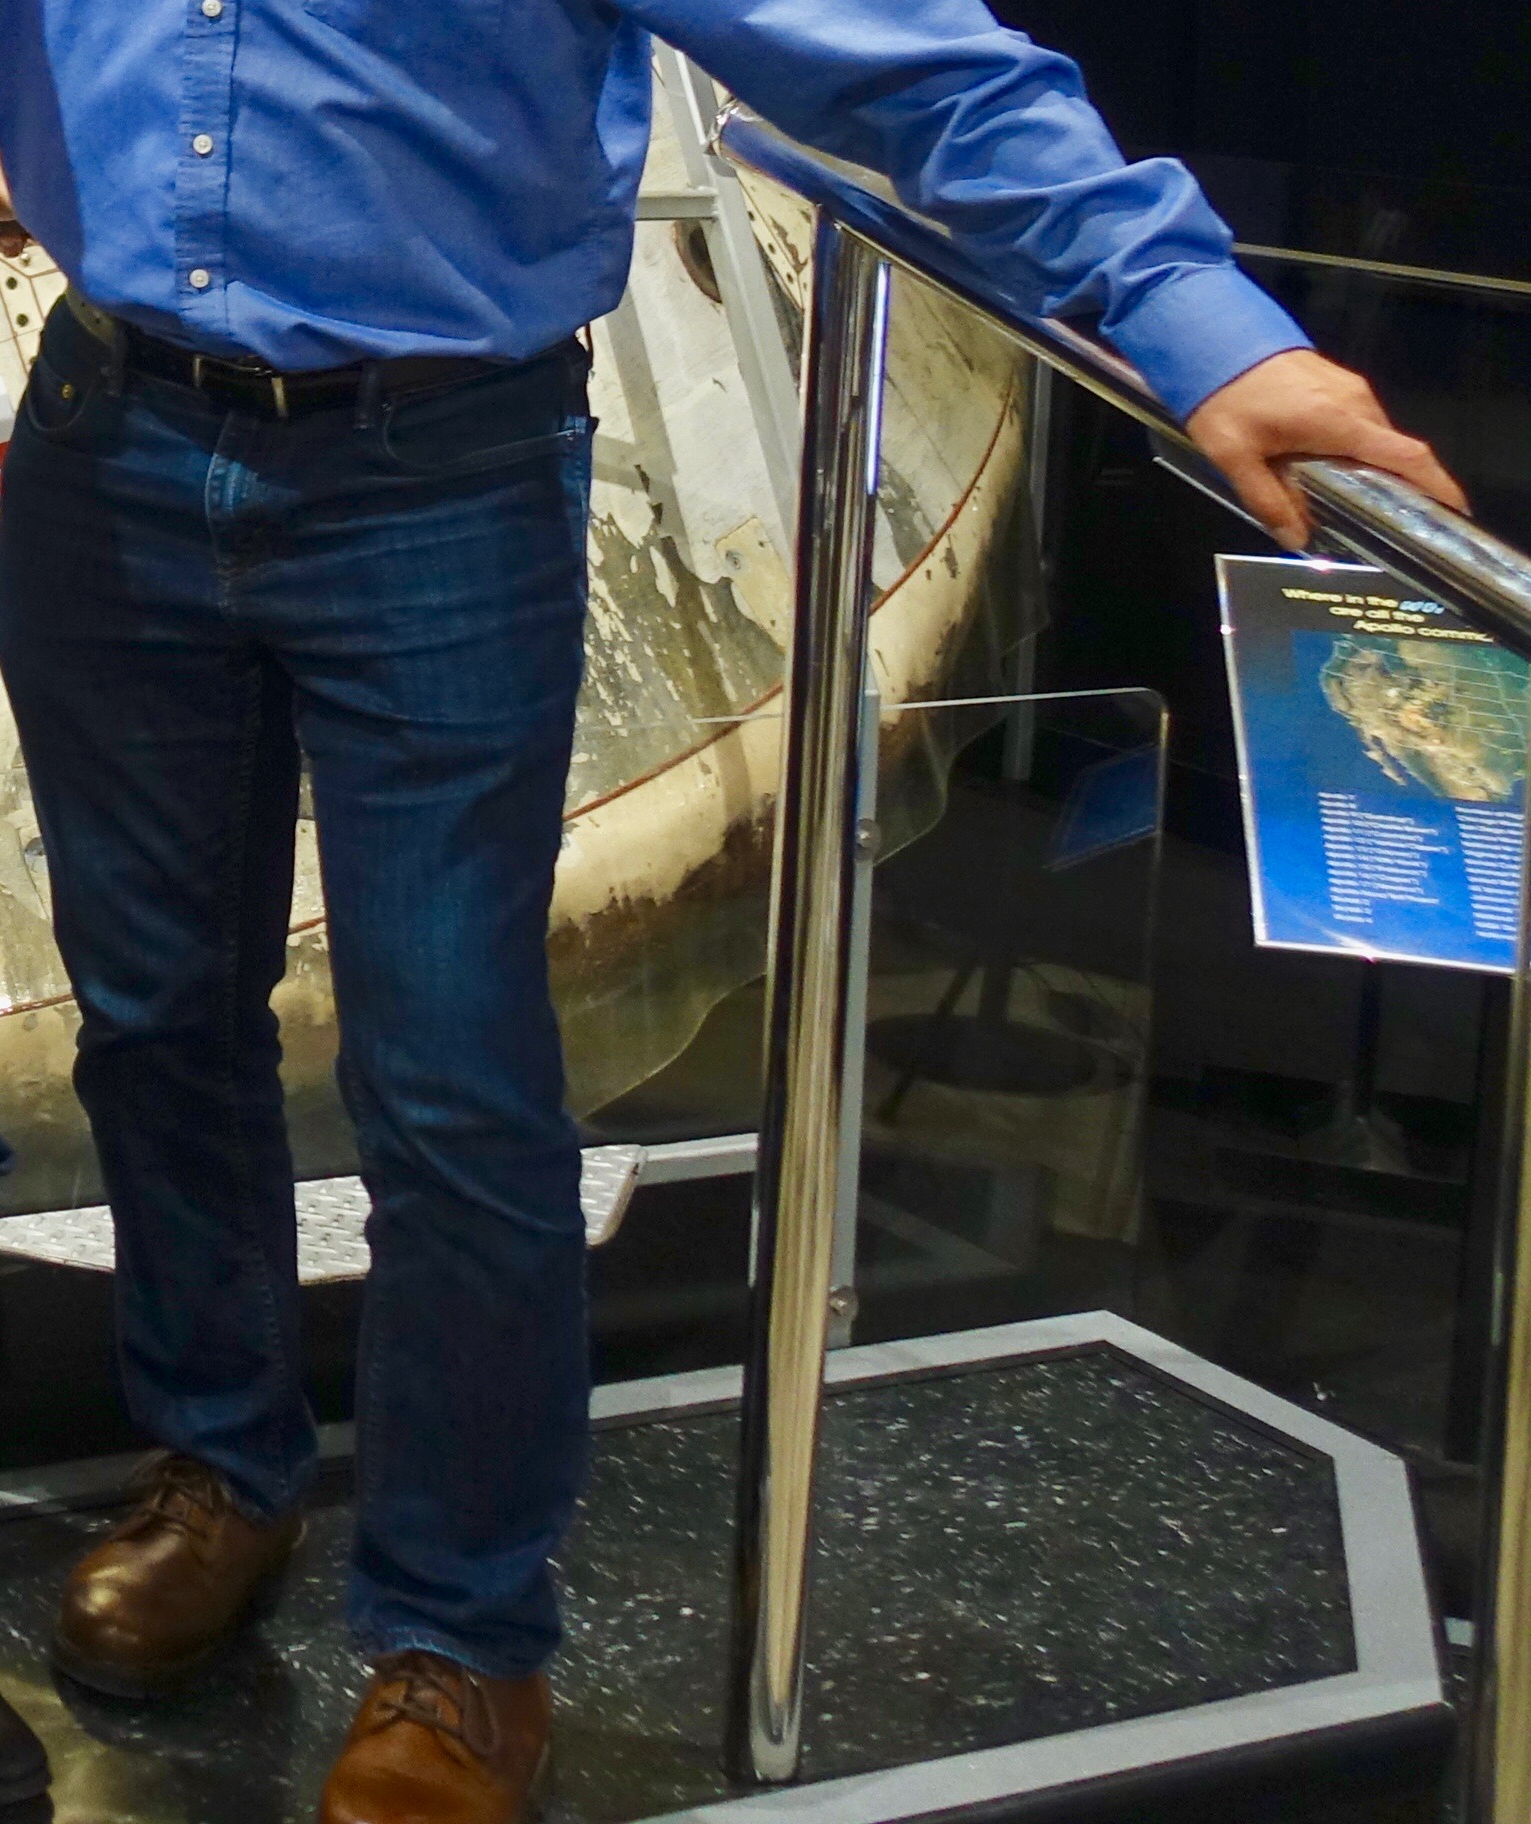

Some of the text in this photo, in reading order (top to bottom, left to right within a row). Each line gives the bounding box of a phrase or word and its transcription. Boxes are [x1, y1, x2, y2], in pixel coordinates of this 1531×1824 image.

[1344, 593, 1364, 605] in
[1365, 595, 1399, 608] the
[1353, 619, 1415, 635] Apollo
